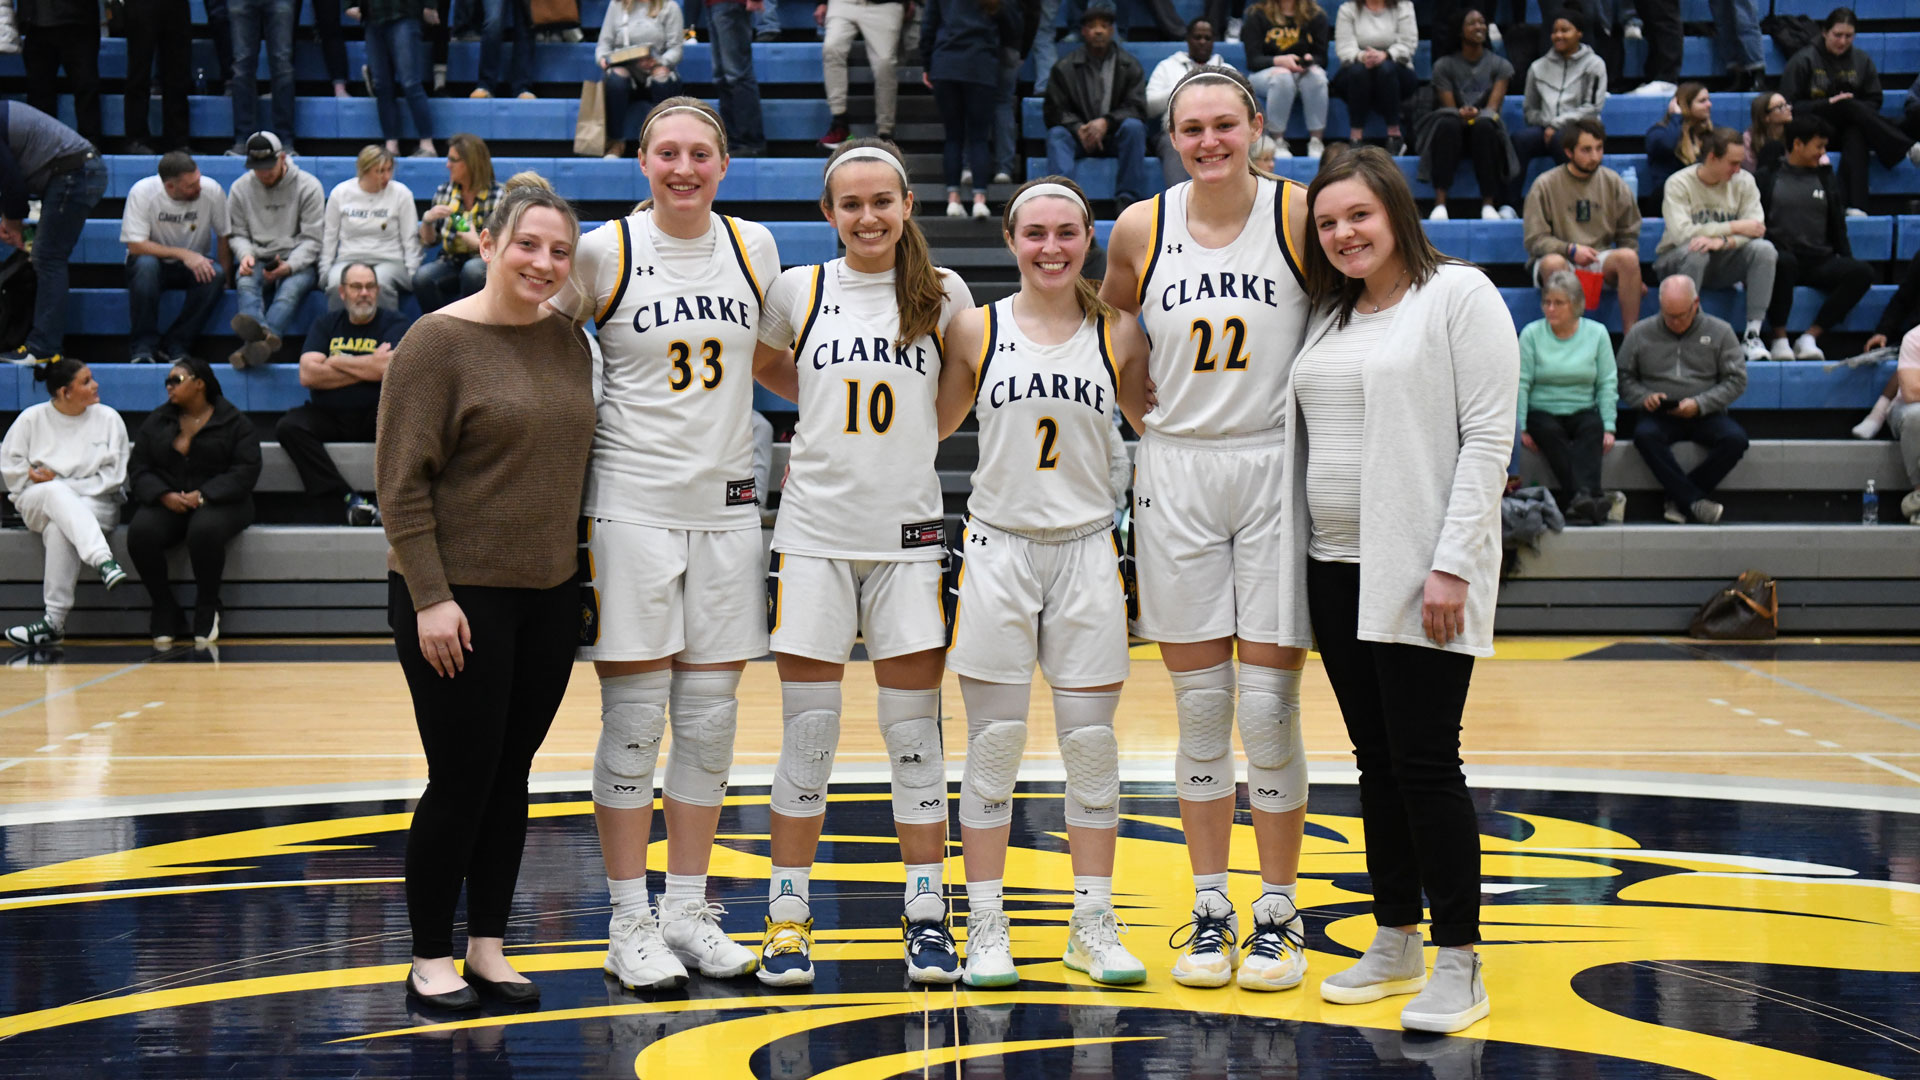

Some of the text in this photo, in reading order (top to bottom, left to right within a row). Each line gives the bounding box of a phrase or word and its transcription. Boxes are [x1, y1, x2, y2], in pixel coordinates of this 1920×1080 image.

[1162, 271, 1278, 312] CLARKE
[633, 295, 751, 334] CLARKE
[329, 336, 378, 354] CLARKE
[667, 337, 724, 393] 33
[813, 336, 927, 376] CLARKE
[1190, 315, 1251, 374] 22
[843, 378, 896, 436] 10
[990, 372, 1106, 416] CLARKE
[1035, 415, 1061, 471] 2
